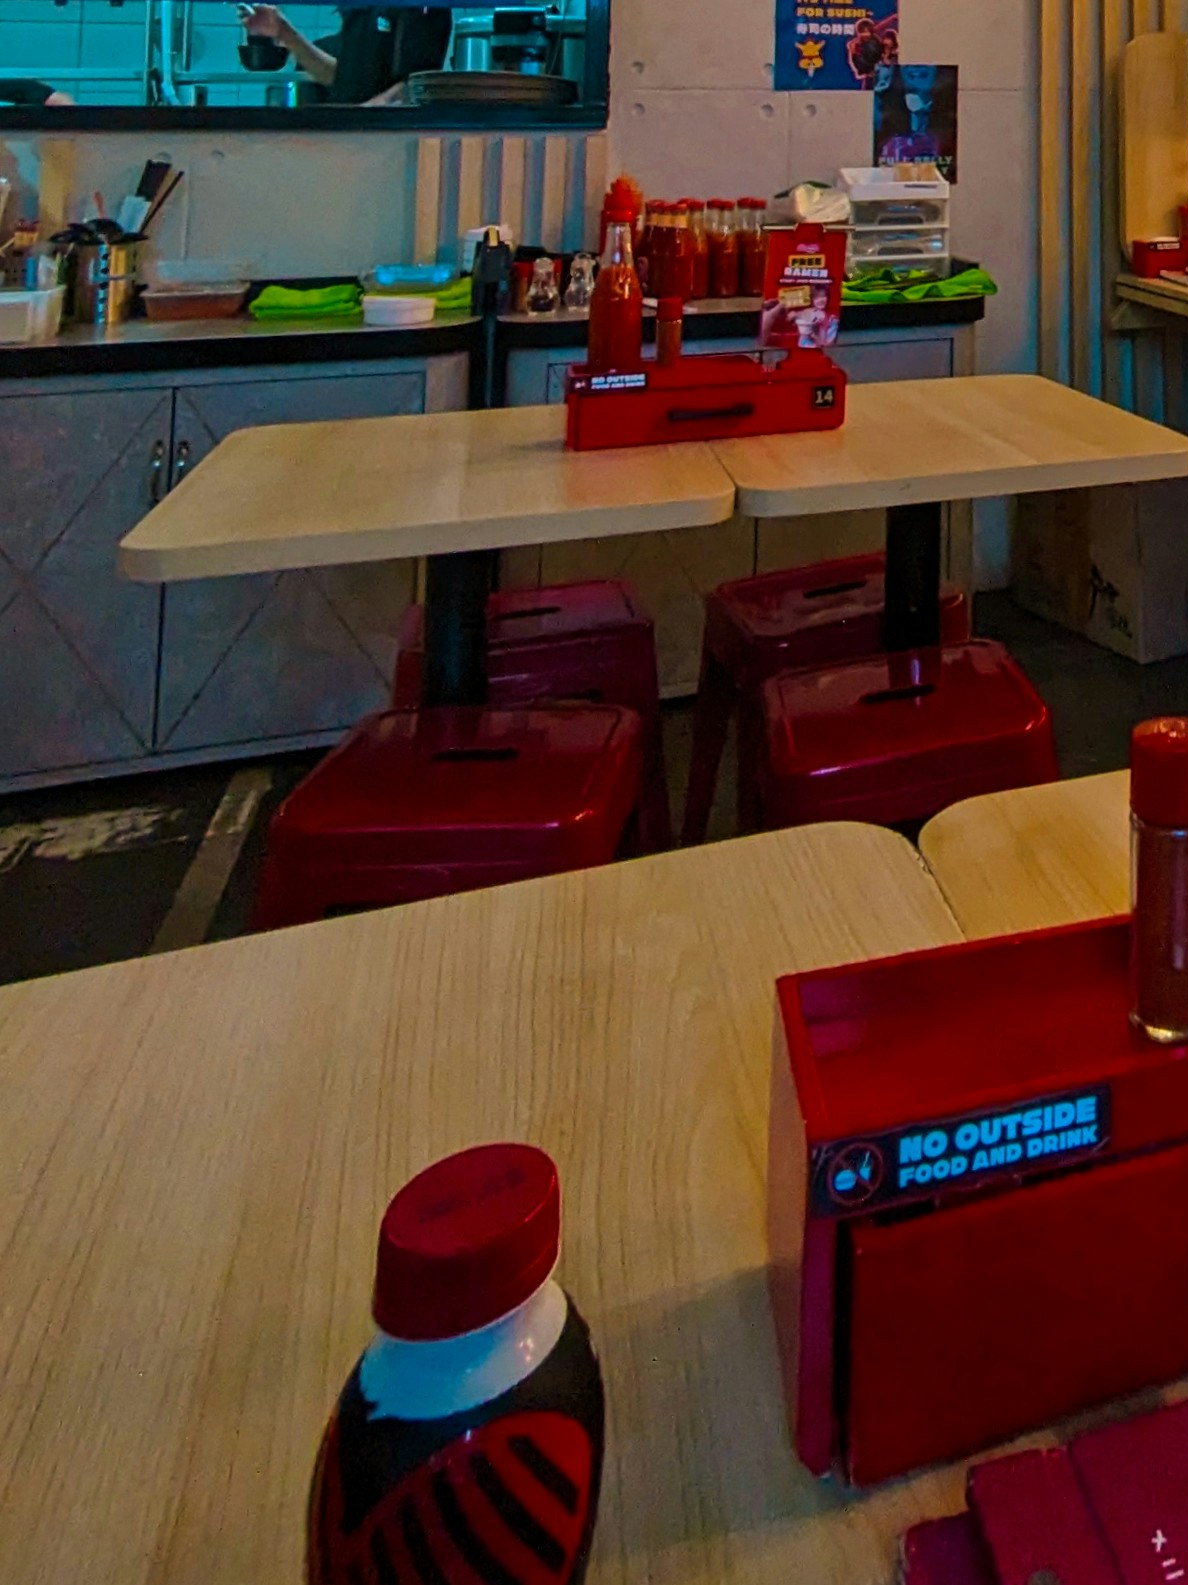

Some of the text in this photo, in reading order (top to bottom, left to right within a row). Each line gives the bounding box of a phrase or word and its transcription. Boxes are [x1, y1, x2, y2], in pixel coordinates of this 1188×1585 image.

[797, 7, 824, 18] FOR
[791, 257, 822, 267] FREE
[784, 267, 829, 278] RAMEN
[815, 389, 834, 404] 14
[899, 1096, 1097, 1164] NO OUTSIDE
[899, 1124, 1098, 1189] FOOD AND DRINK
